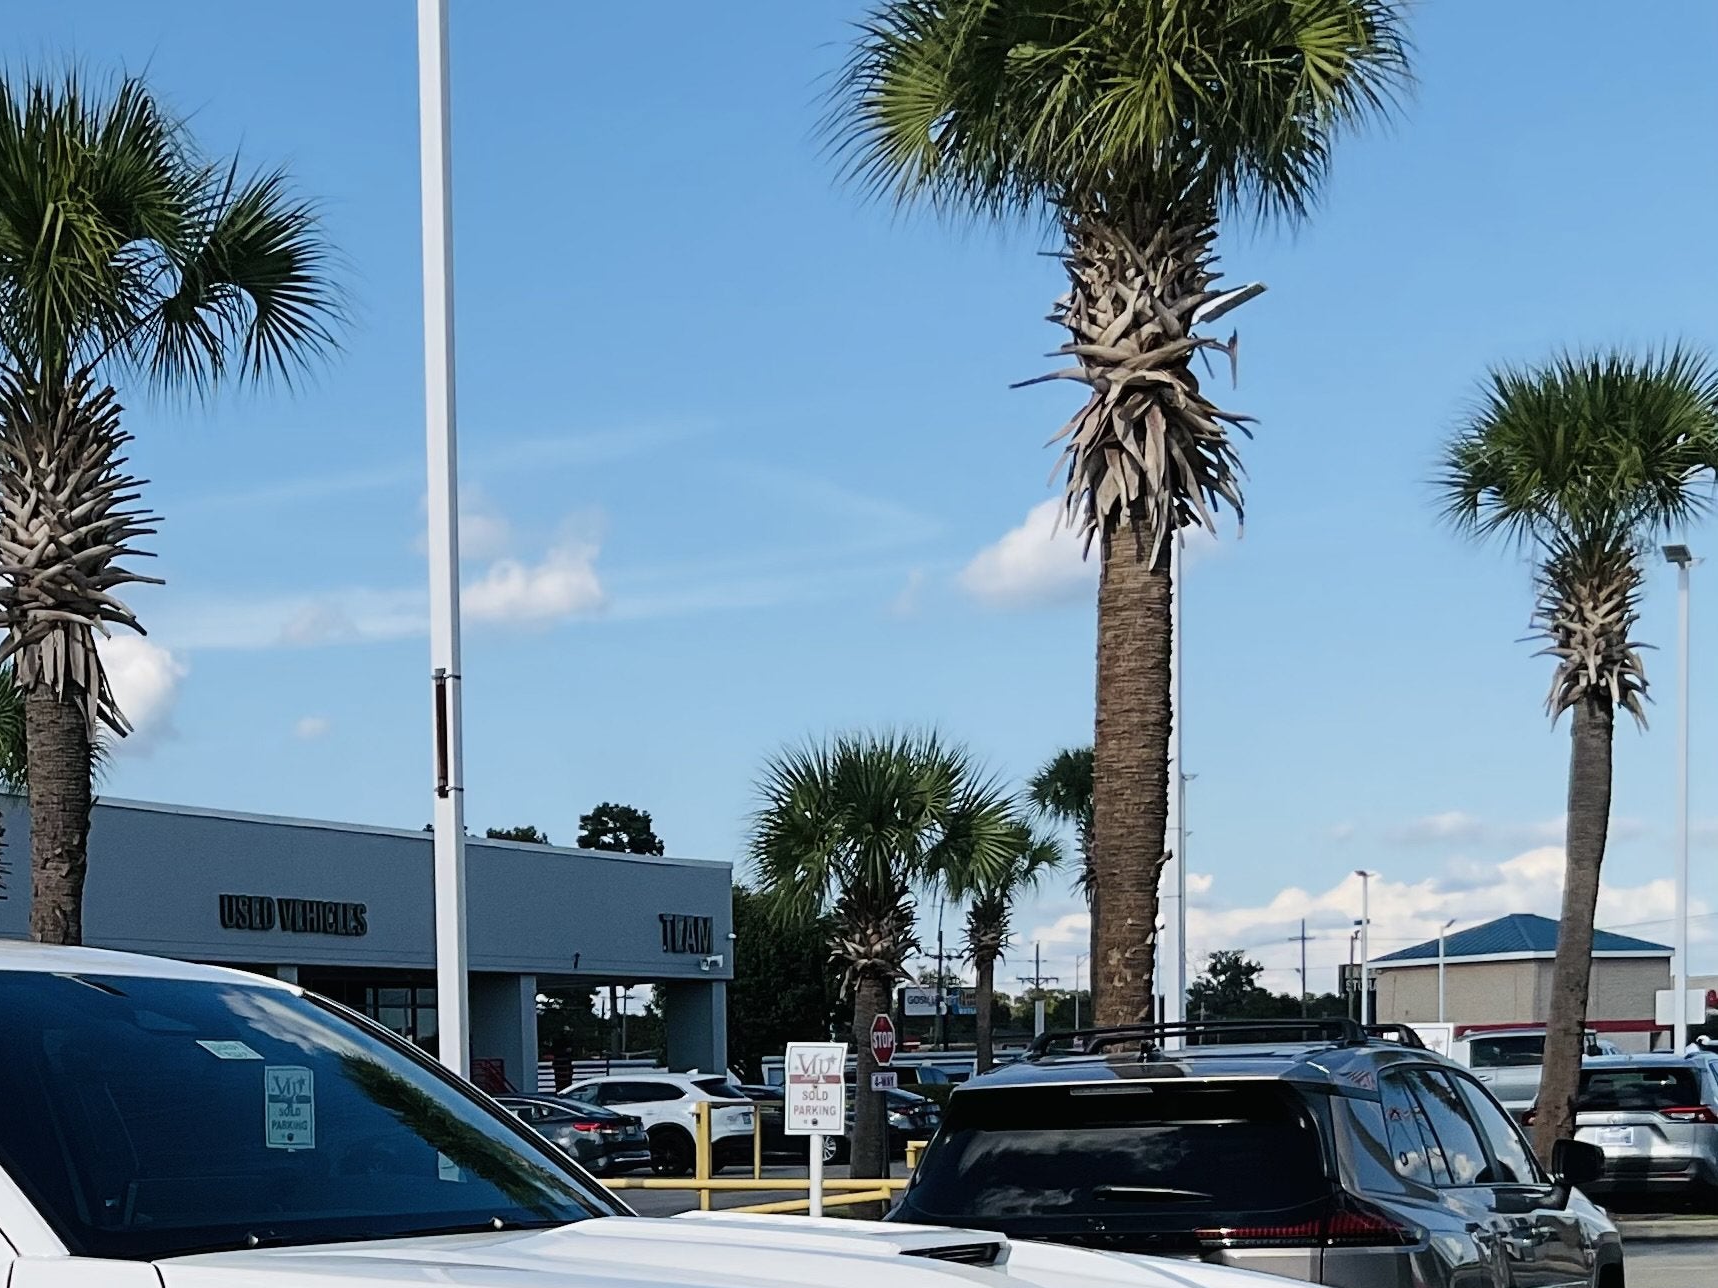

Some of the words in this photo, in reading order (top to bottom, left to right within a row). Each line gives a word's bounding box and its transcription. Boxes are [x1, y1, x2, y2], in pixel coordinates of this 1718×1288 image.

[219, 894, 275, 930] USED
[277, 898, 368, 937] VEHICLES
[658, 913, 714, 955] TEAM
[873, 1031, 893, 1049] STOP
[802, 1091, 829, 1101] SOLD
[278, 1108, 301, 1117] SOLD
[793, 1105, 837, 1117] PARKING
[271, 1120, 308, 1131] PARKING
